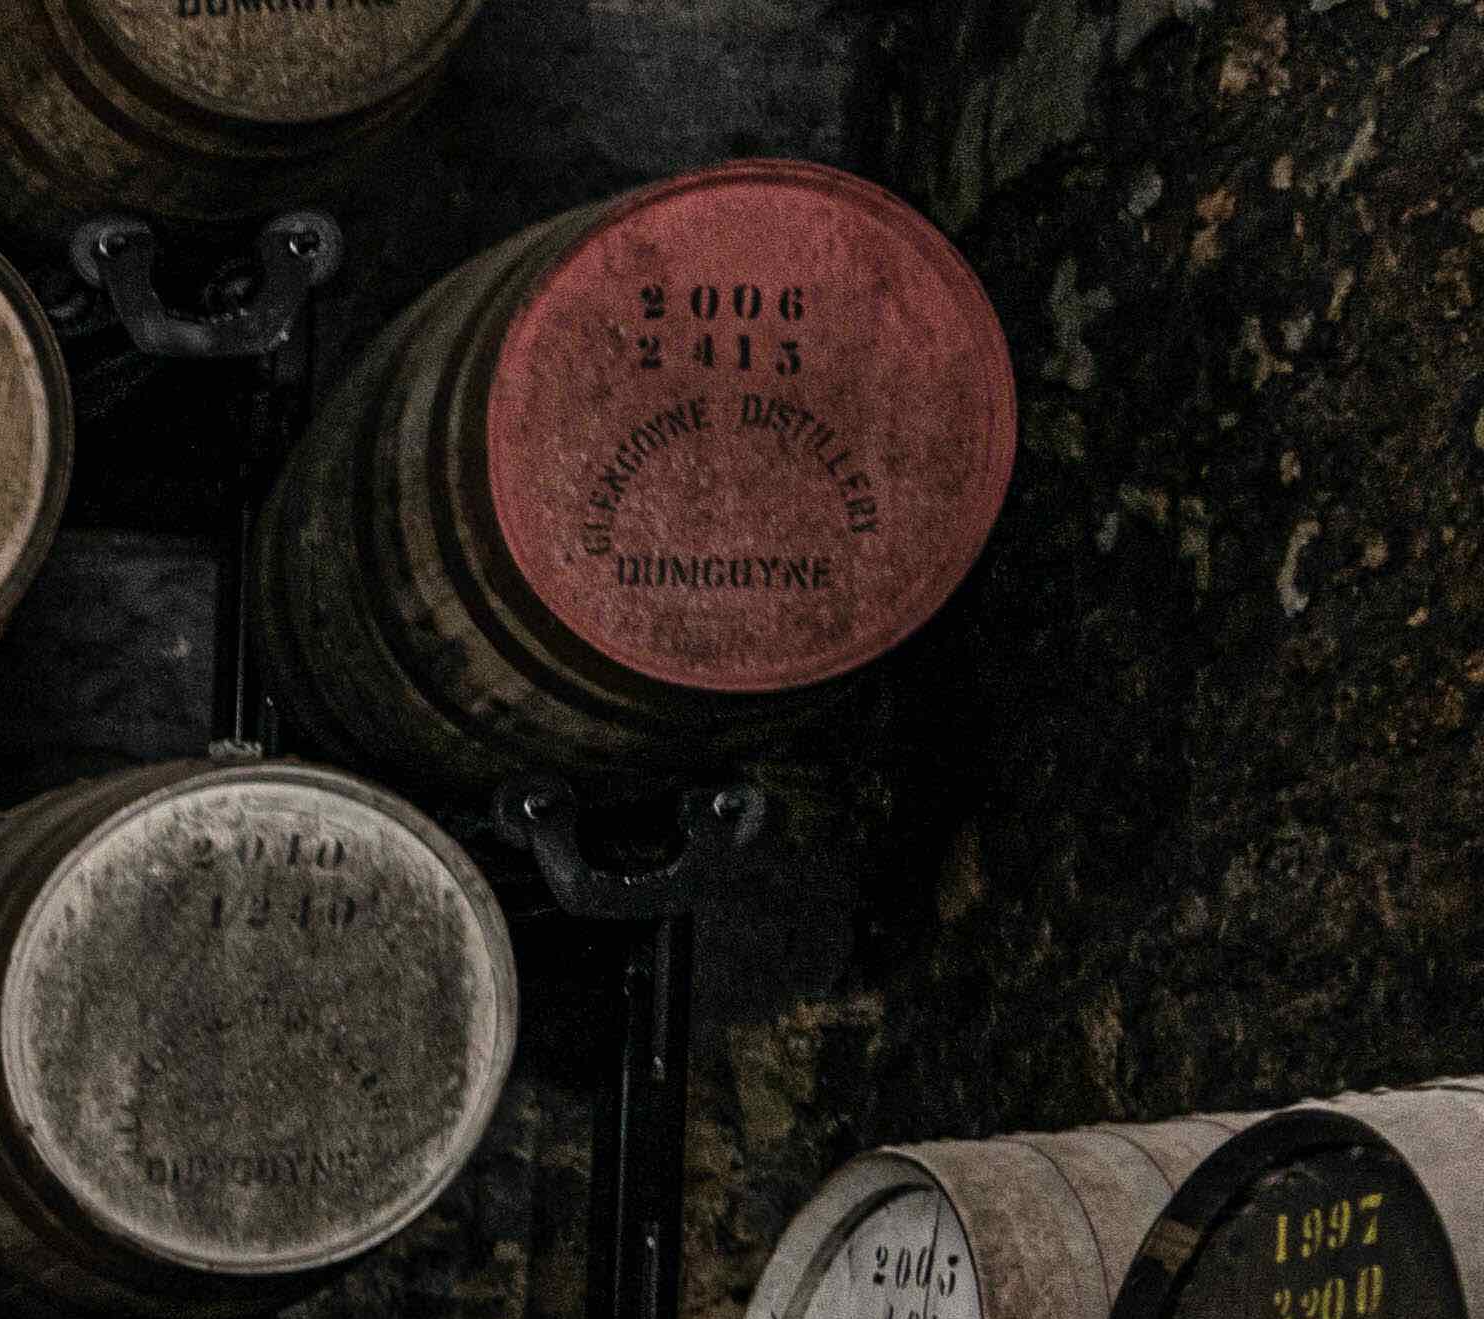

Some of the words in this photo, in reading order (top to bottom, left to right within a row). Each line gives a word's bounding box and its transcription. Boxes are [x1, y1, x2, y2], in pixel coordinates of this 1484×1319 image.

[640, 284, 805, 323] 2006
[583, 397, 712, 556] GLENGOYNE
[738, 394, 877, 537] DISTILLERY
[616, 556, 834, 590] DUMGOYNE
[1274, 1190, 1385, 1264] 1997
